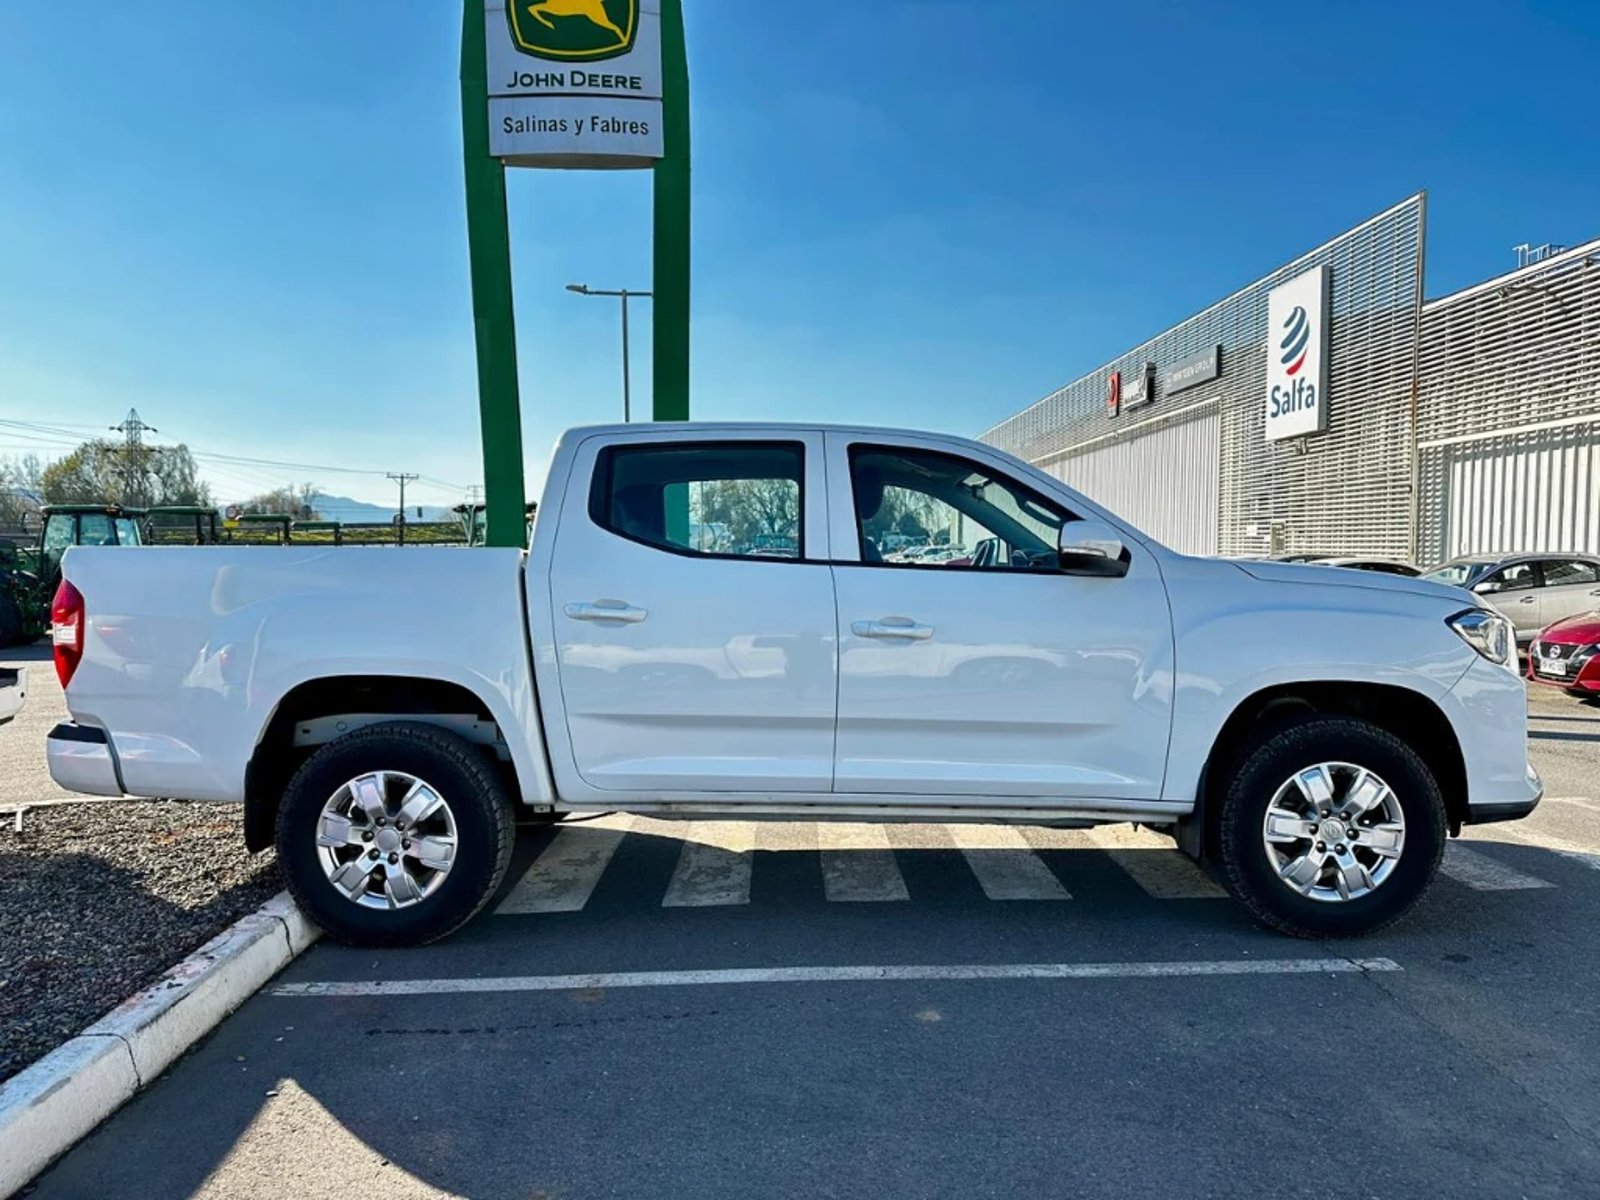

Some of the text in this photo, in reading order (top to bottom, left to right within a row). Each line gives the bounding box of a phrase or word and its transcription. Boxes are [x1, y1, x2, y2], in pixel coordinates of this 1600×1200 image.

[506, 71, 643, 90] JOHN DEERE
[503, 114, 650, 136] Salinas y Fabres
[1270, 376, 1316, 419] Salfa
